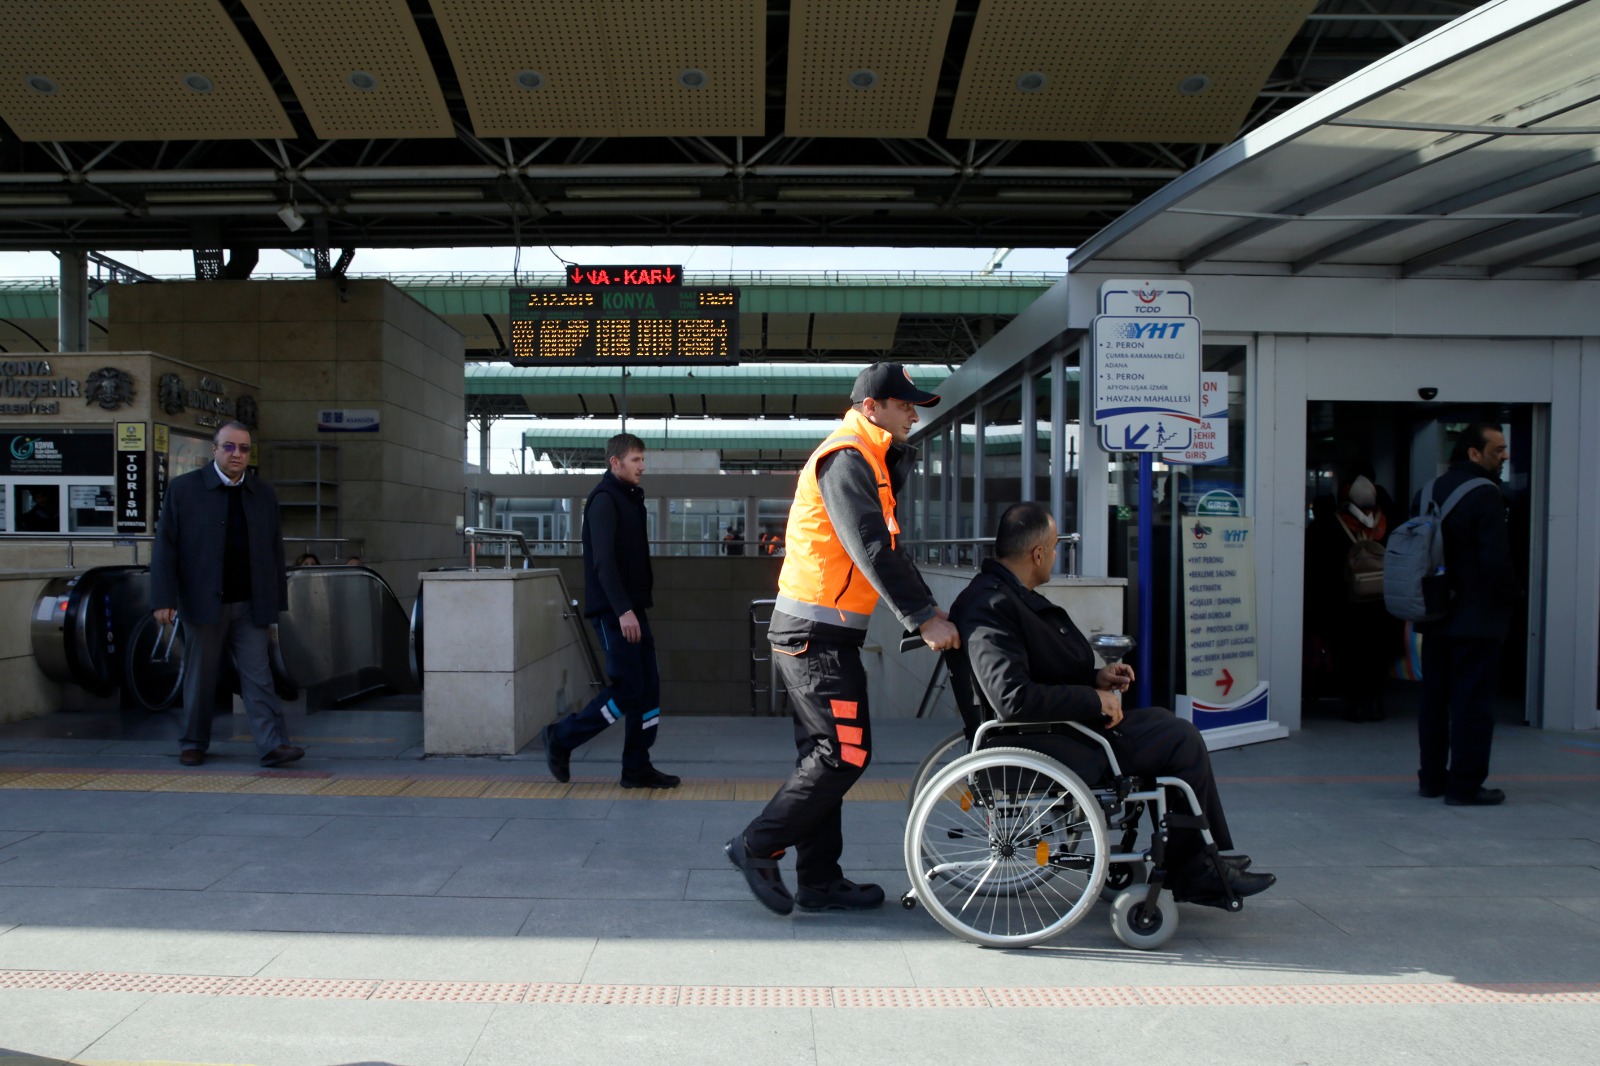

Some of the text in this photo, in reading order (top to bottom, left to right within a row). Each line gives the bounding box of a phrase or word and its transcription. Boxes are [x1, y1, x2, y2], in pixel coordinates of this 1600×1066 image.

[602, 292, 655, 309] KONYA
[1134, 322, 1185, 339] YHT
[0, 377, 81, 400] ÜKŞEHİR
[1203, 382, 1217, 392] ON
[1144, 394, 1191, 402] MAHALLESİ
[0, 401, 59, 414] ELEDİYESİ
[126, 454, 138, 517] TOURISM
[1224, 530, 1248, 542] YHT
[1206, 625, 1233, 633] PROTOKOL
